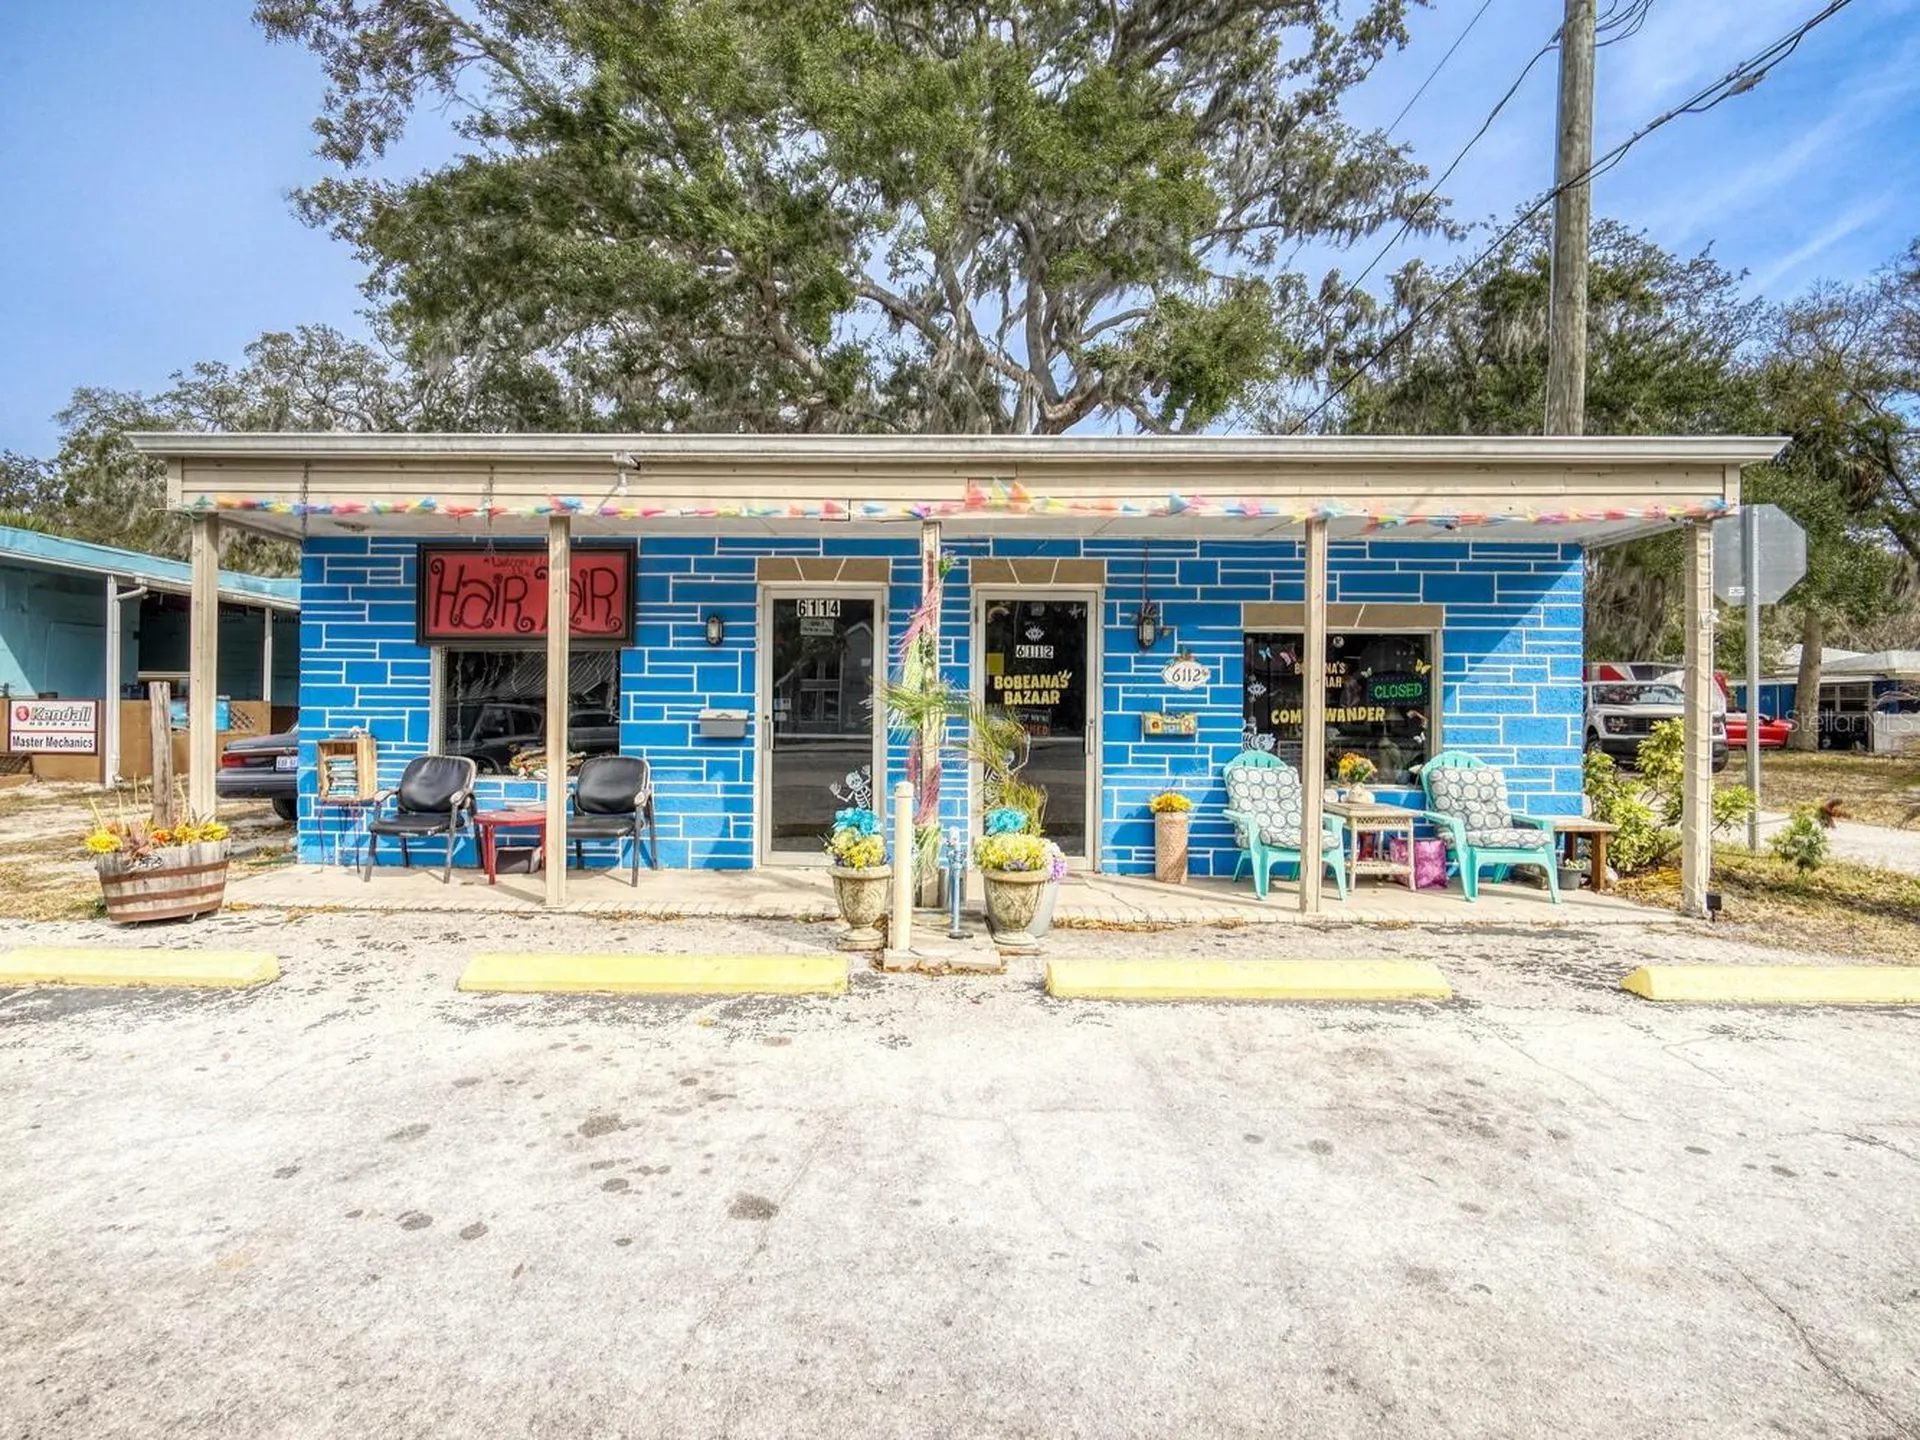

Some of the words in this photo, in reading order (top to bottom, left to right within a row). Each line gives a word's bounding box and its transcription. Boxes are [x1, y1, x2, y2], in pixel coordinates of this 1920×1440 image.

[799, 600, 839, 616] 6114
[1017, 645, 1053, 658] 6112
[1172, 668, 1201, 682] 6112
[1004, 690, 1060, 705] BAZAAR
[1374, 683, 1423, 699] CLOSED
[30, 706, 92, 722] Kendall
[1271, 709, 1302, 725] COM
[1324, 707, 1386, 723] WANDER
[12, 735, 43, 748] Master
[45, 736, 93, 749] Mechanics
